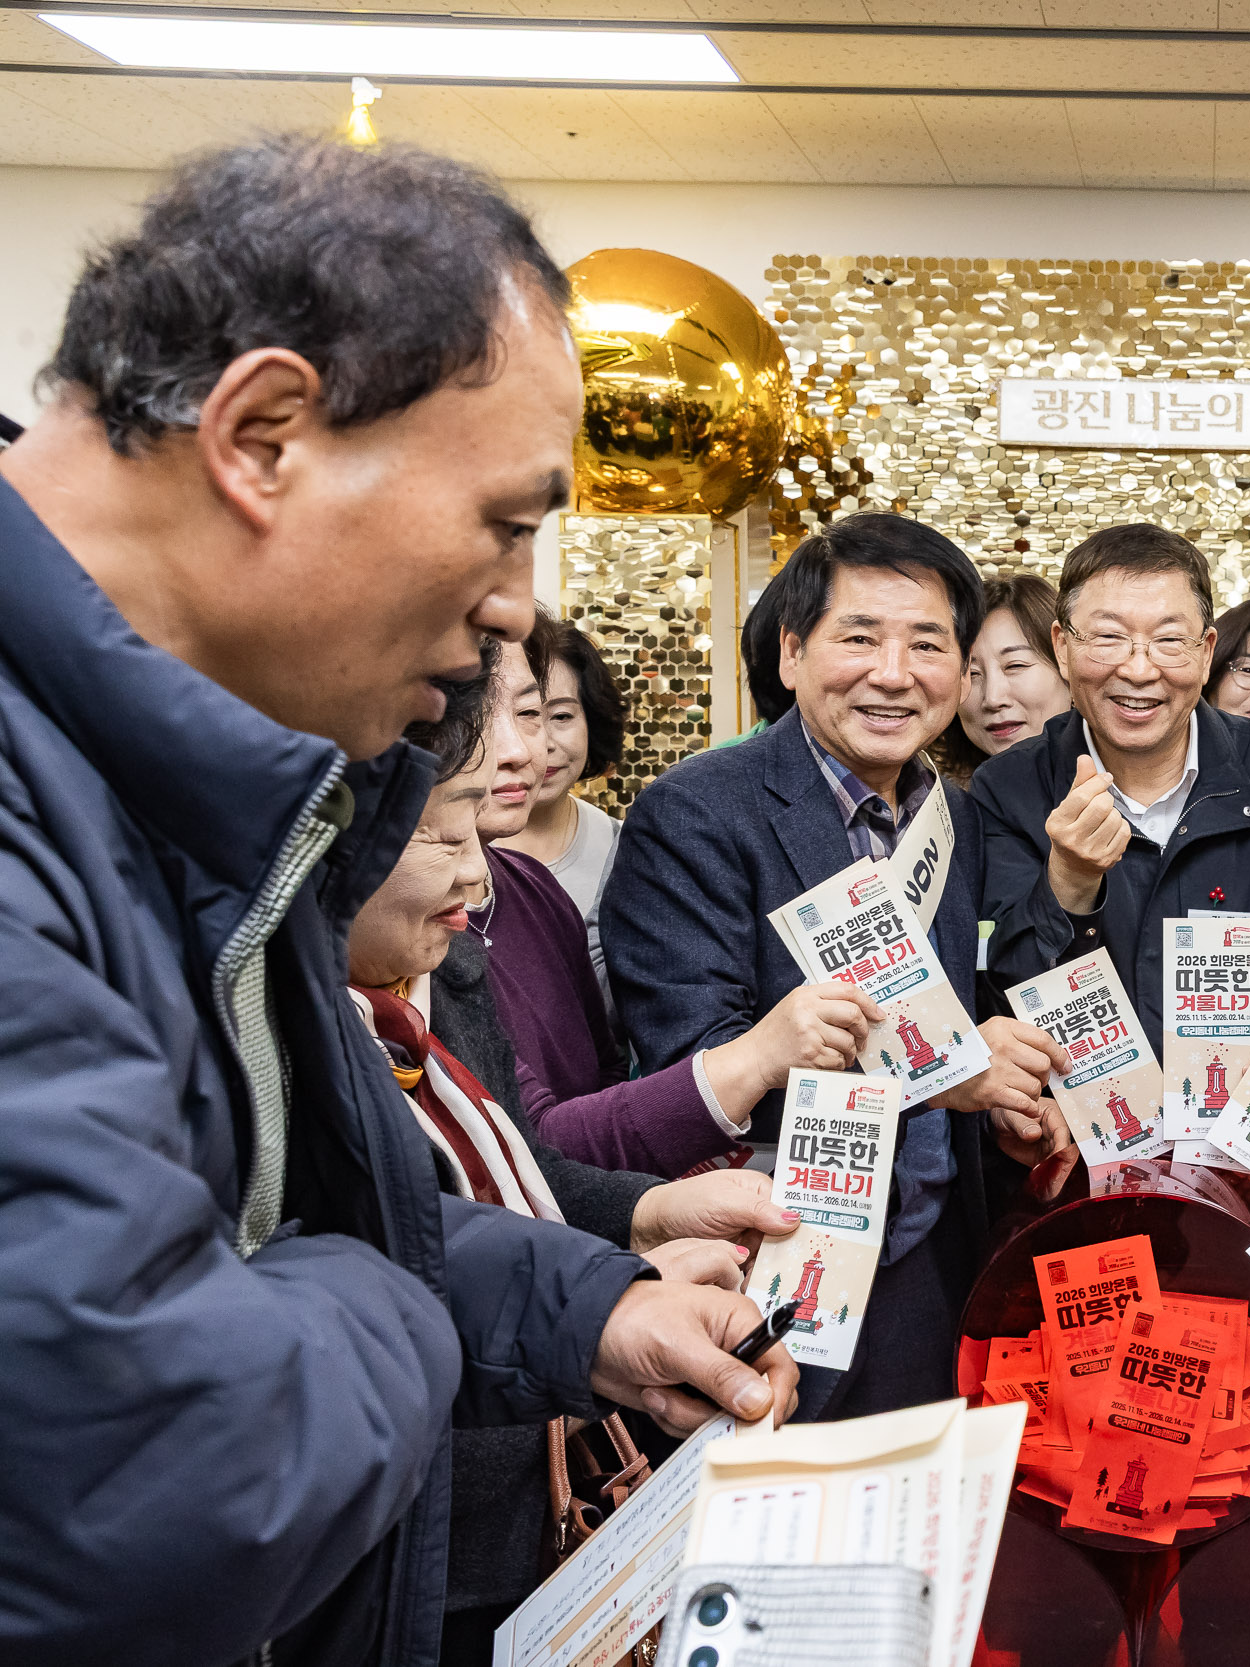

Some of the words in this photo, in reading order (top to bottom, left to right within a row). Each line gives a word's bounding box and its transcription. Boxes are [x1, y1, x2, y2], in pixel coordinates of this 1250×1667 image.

[1032, 389, 1110, 430] 광진
[1126, 391, 1244, 433] 나눔의
[813, 926, 845, 947] 2026
[845, 900, 896, 932] 희망온돌
[819, 914, 907, 972] 따뜻한
[832, 938, 916, 984] 겨울나기
[1178, 956, 1206, 966] 2026
[1034, 1008, 1063, 1027] 2026
[1064, 986, 1111, 1015] 희망온돌
[795, 1117, 825, 1132] 2026
[829, 1119, 880, 1140] 희망온돌
[789, 1135, 878, 1172] 따뜻한
[787, 1167, 872, 1197] 겨울나기
[1055, 1288, 1086, 1304] 2026
[1089, 1276, 1138, 1297] 희망온돌
[1128, 1343, 1159, 1359] 2026
[1161, 1351, 1210, 1374] 희망온돌
[1120, 1357, 1206, 1399] 따뜻한
[1116, 1381, 1199, 1419] 겨울나기
